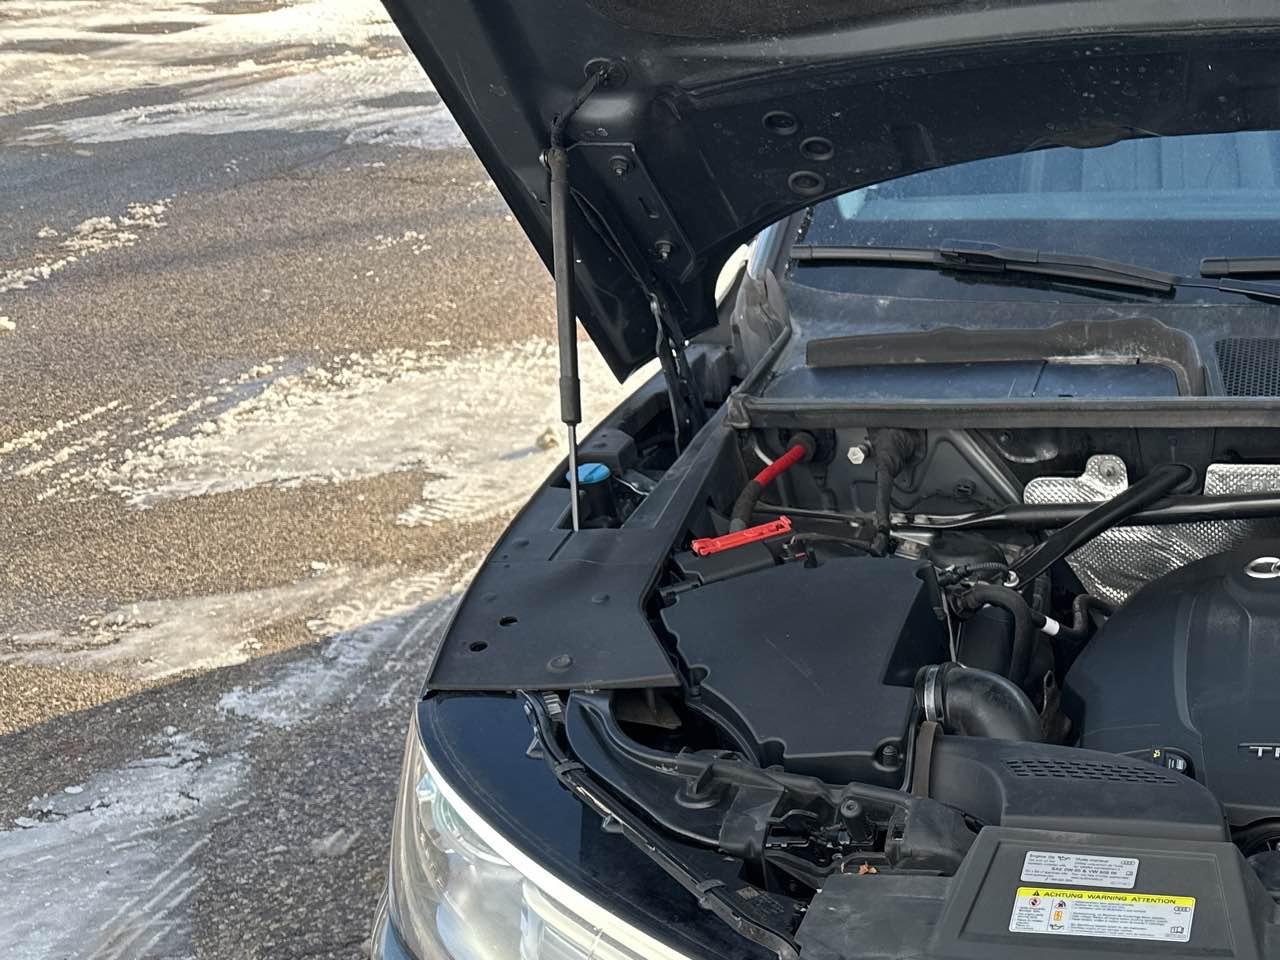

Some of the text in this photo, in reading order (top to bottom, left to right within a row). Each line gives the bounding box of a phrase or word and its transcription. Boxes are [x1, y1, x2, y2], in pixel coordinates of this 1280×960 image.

[1043, 891, 1177, 905] ACHTUNG WARNING ATTENTION
